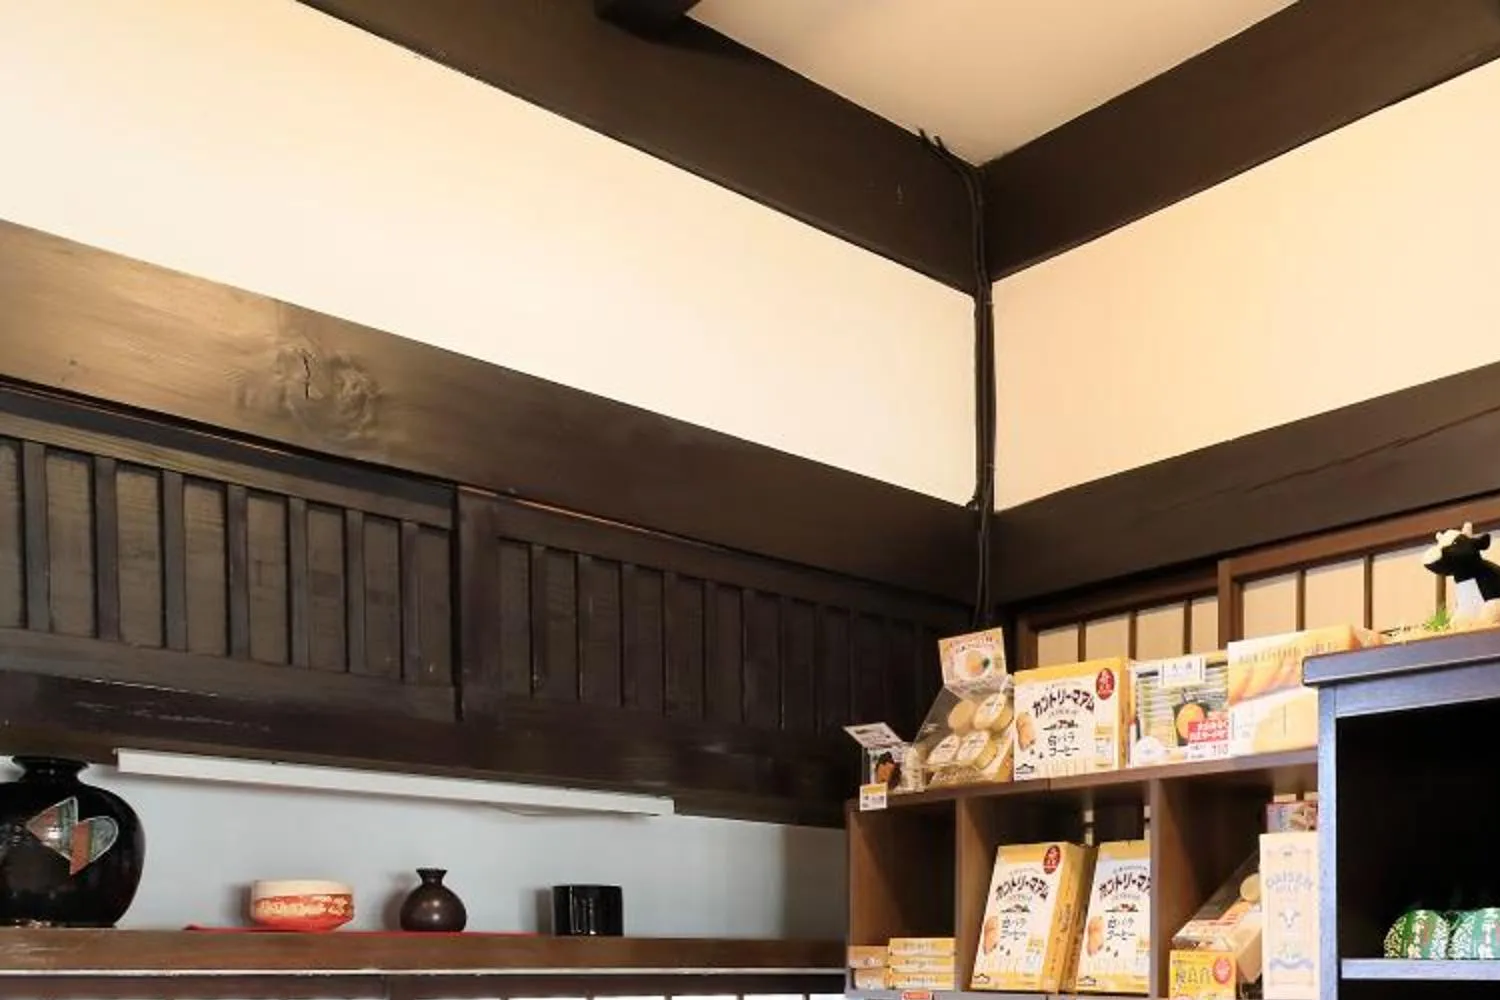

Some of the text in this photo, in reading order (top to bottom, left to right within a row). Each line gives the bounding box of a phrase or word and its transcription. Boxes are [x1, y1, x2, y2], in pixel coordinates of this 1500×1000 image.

[1032, 688, 1096, 719] カントリーマアム
